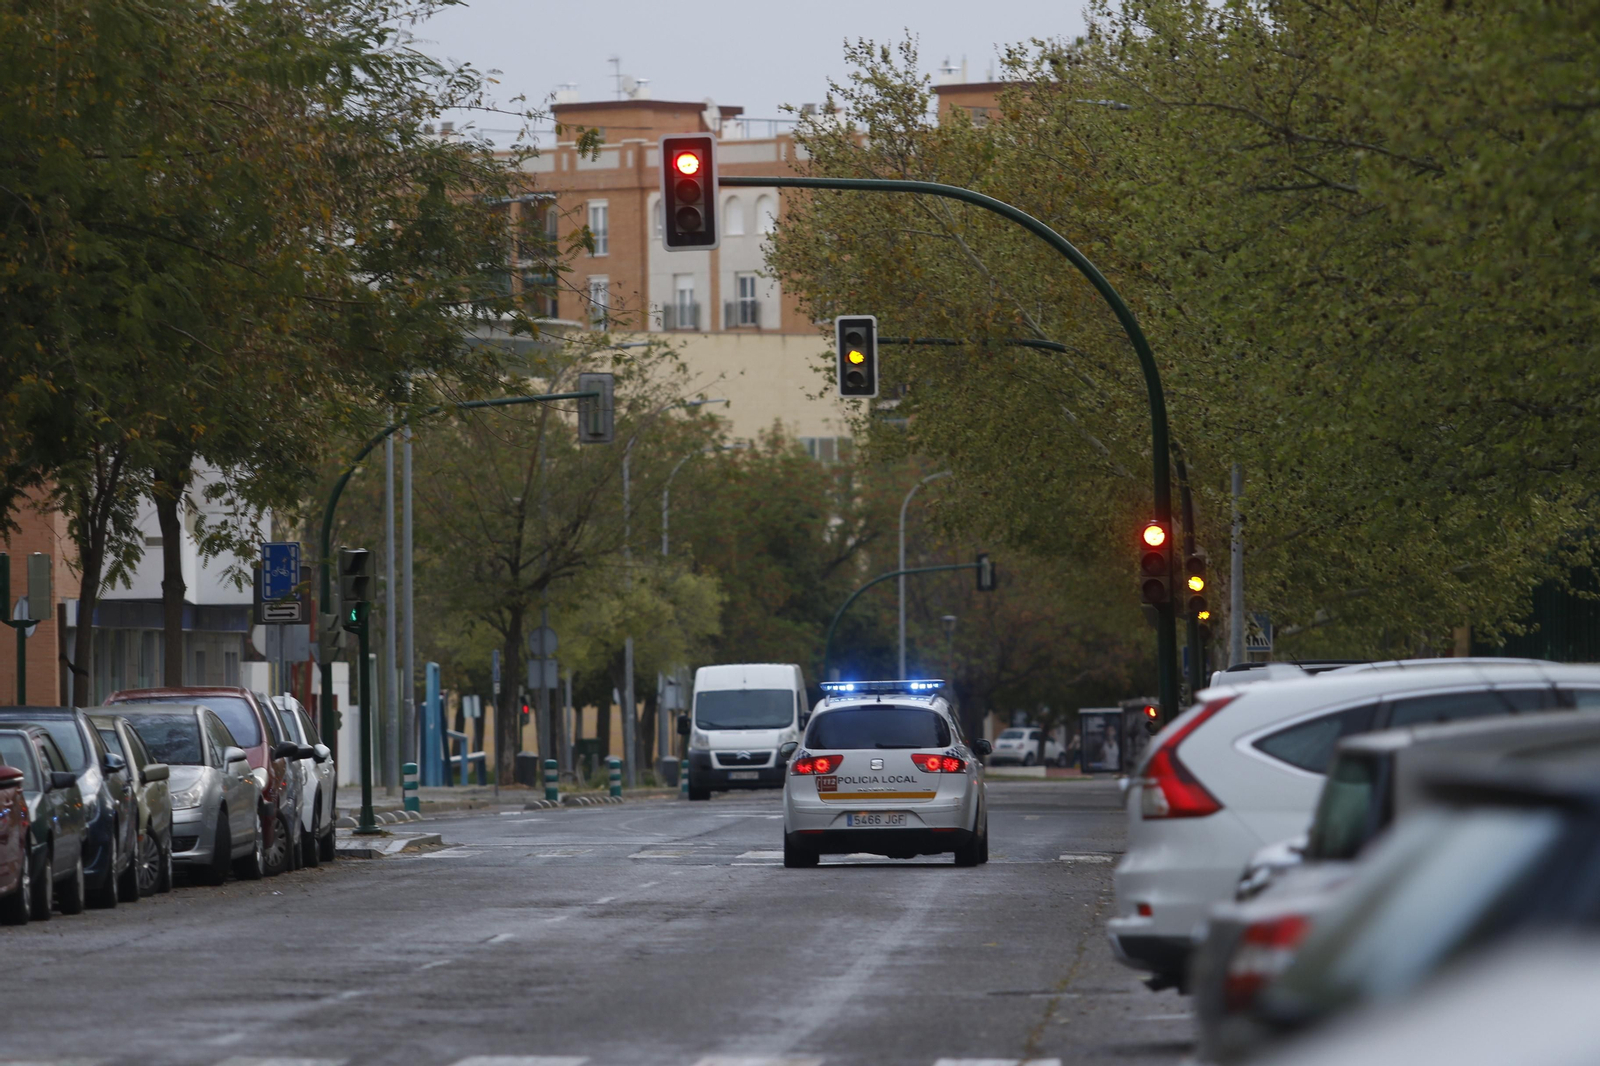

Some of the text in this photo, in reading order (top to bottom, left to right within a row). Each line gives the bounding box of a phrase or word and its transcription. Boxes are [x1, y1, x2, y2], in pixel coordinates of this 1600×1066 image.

[838, 775, 917, 784] POLICIA LOCAL
[854, 814, 904, 825] 5466 JGF
